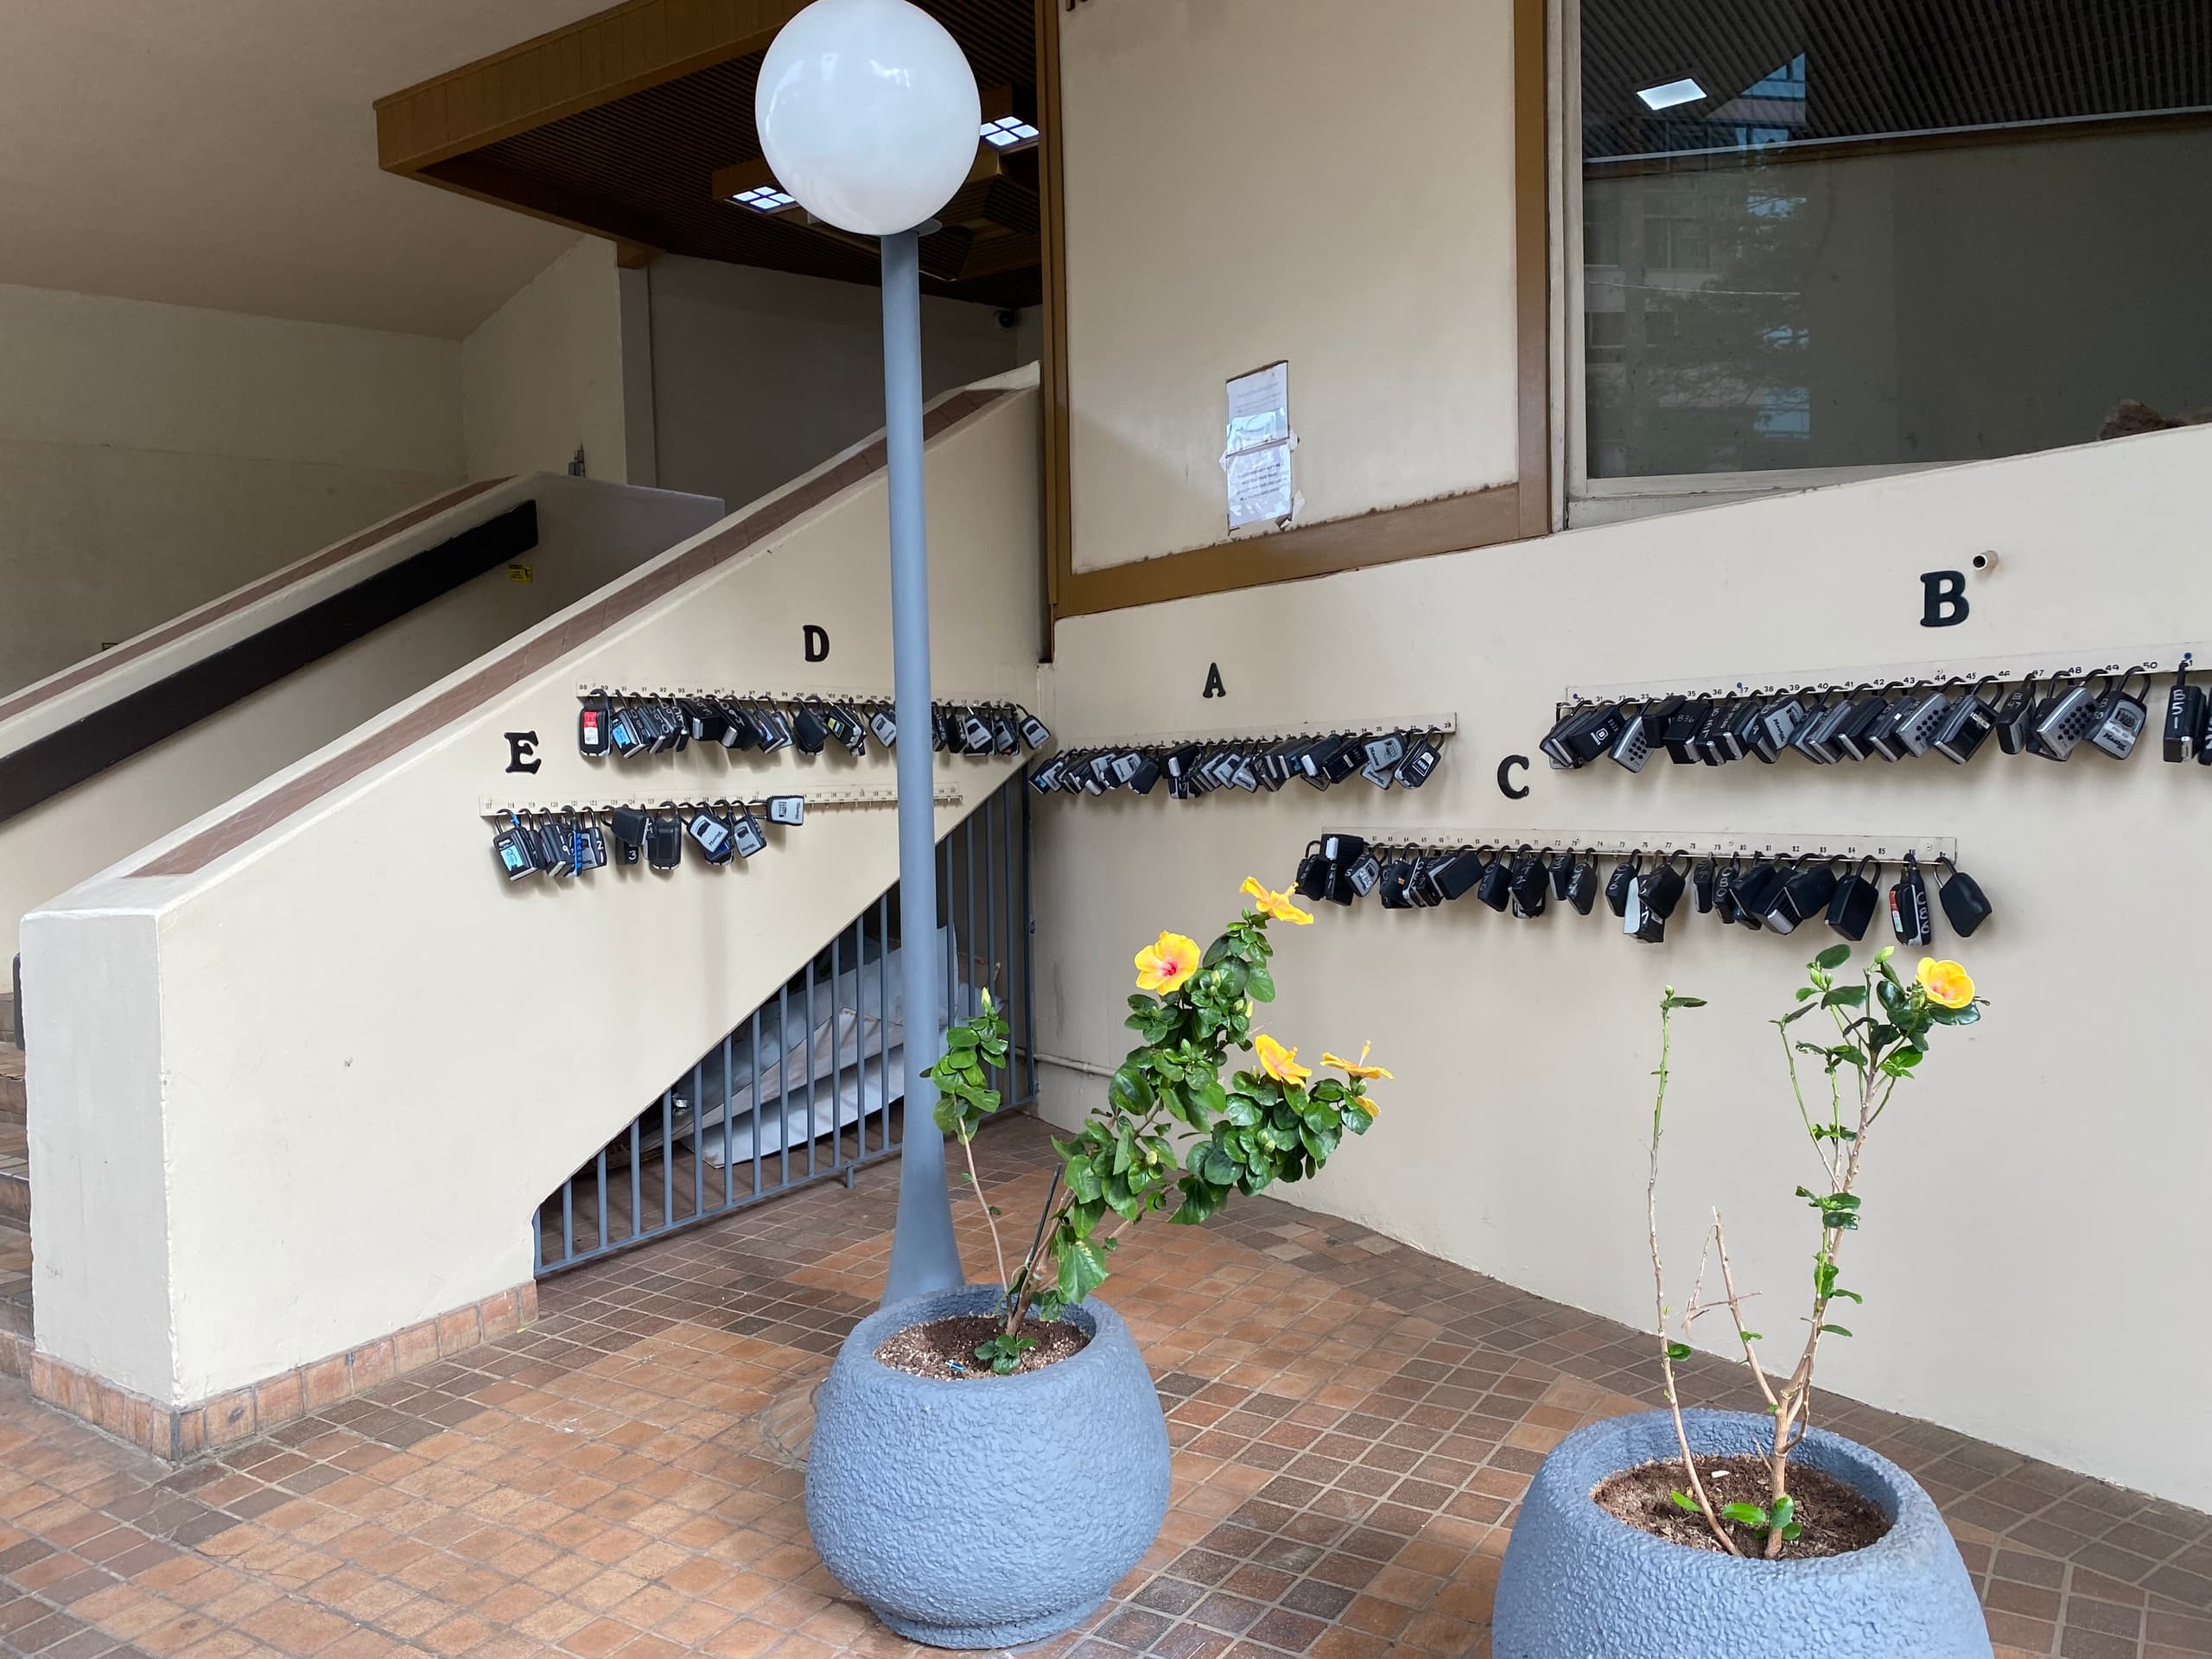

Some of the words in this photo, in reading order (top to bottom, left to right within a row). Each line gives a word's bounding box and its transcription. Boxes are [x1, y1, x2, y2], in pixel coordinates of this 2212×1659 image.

[1920, 571, 1970, 628] B
[803, 624, 830, 663] D
[1202, 662, 1227, 699] A
[504, 730, 542, 775] E
[1497, 754, 1529, 800] C
